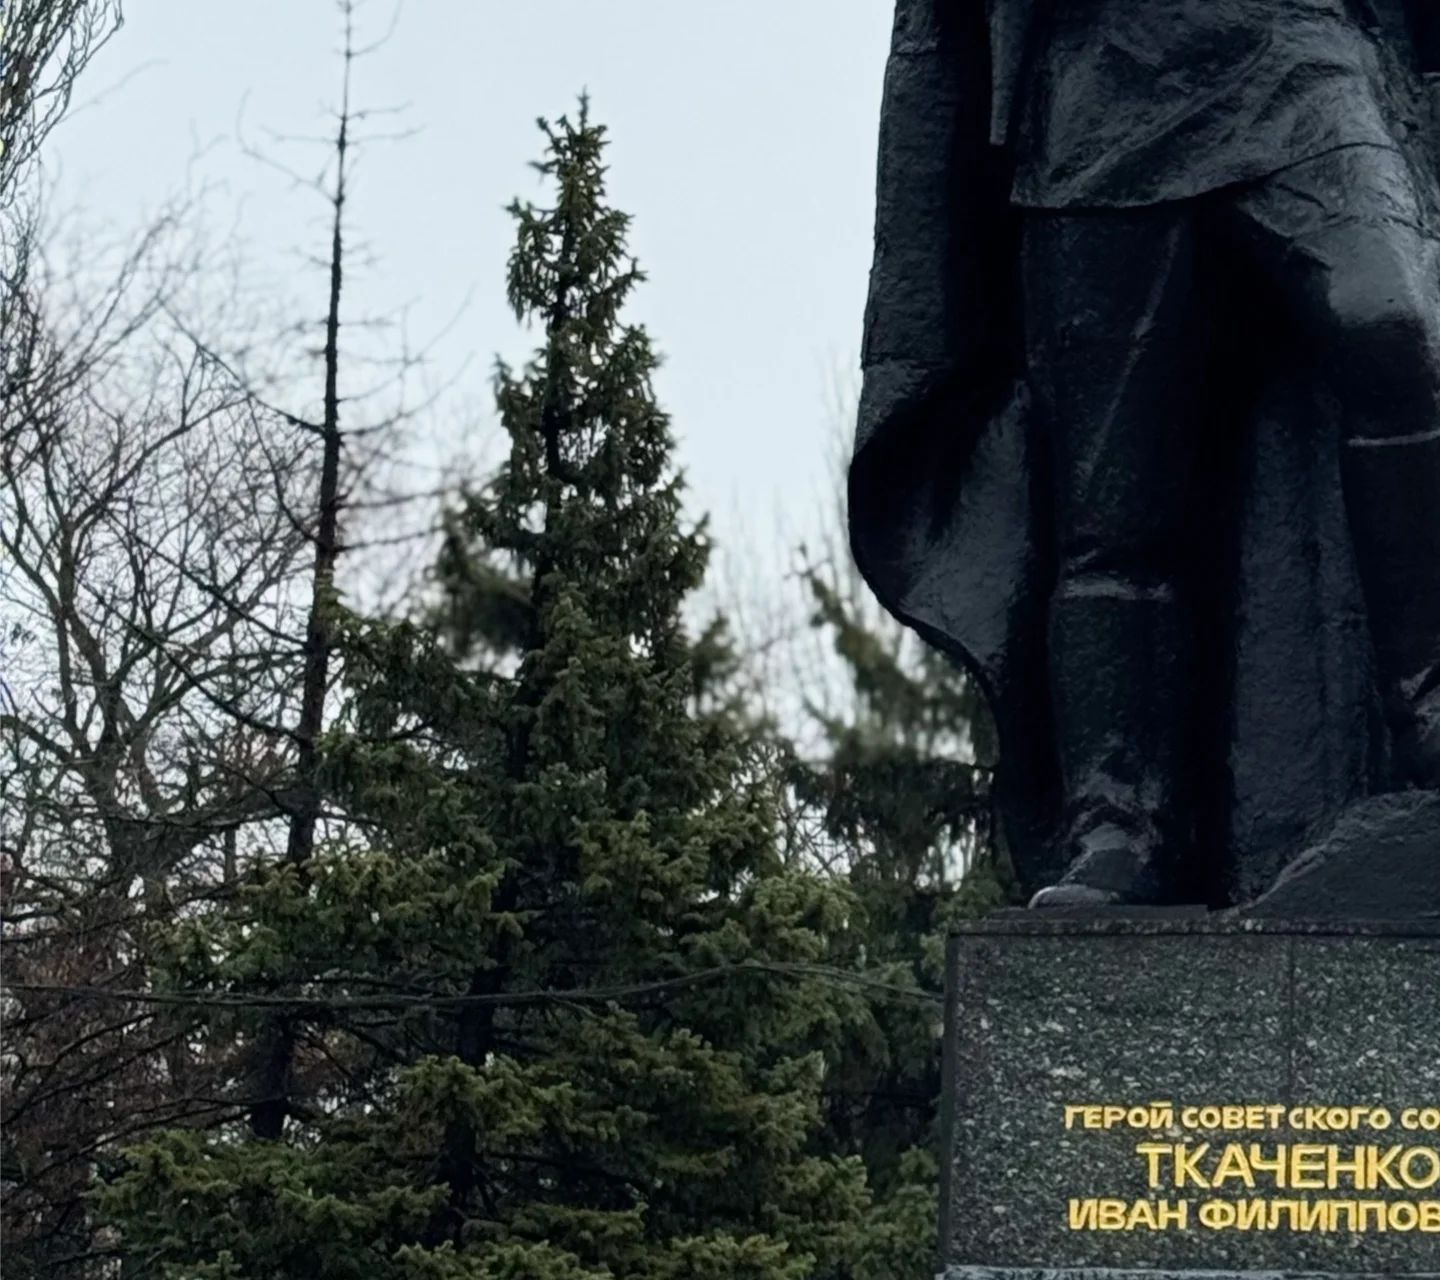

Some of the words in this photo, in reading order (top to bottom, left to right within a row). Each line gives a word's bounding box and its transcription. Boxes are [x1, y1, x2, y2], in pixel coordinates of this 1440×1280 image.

[1064, 1102, 1173, 1130] ГЕРОЙ
[1181, 1105, 1391, 1131] СОВЕТСКОГО
[1068, 1199, 1188, 1231] ИВАН
